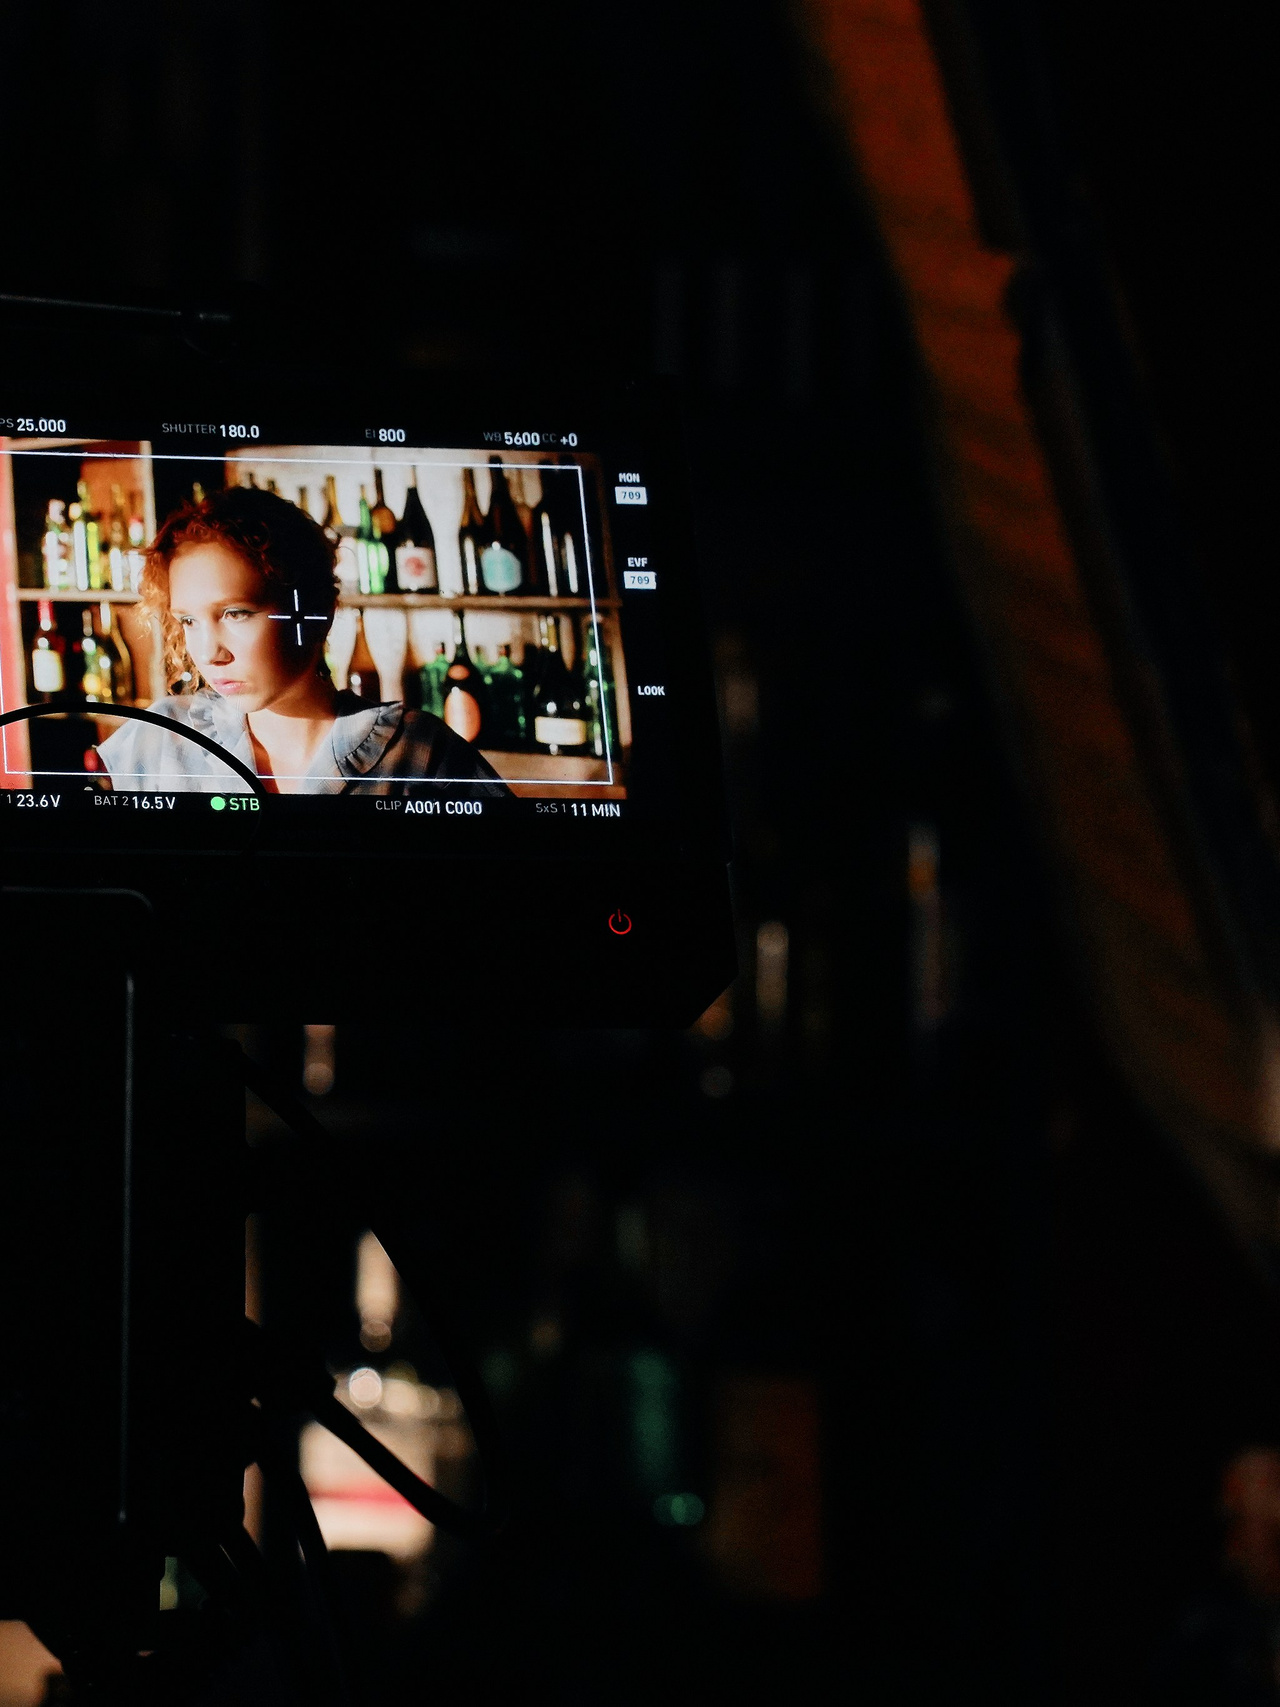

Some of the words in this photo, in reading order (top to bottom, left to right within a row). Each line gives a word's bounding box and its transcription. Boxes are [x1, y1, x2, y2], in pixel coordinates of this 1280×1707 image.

[17, 418, 66, 432] 25.000
[162, 423, 216, 433] SHUTTER
[220, 425, 259, 438] 180.0
[379, 429, 405, 442] 800
[504, 432, 540, 445] 5600
[560, 433, 577, 446] +0
[619, 473, 640, 483] MON
[628, 557, 647, 567] EVF
[638, 686, 665, 695] LOOK
[17, 794, 60, 807] 23.6V
[95, 796, 118, 805] BAT
[132, 796, 175, 809] 16.5V
[229, 798, 259, 810] STB
[376, 800, 401, 810] CLIP
[405, 801, 440, 814] A001
[446, 801, 482, 814] C000
[536, 803, 557, 813] SxS
[571, 803, 587, 816] 11
[592, 803, 620, 817] MIN
